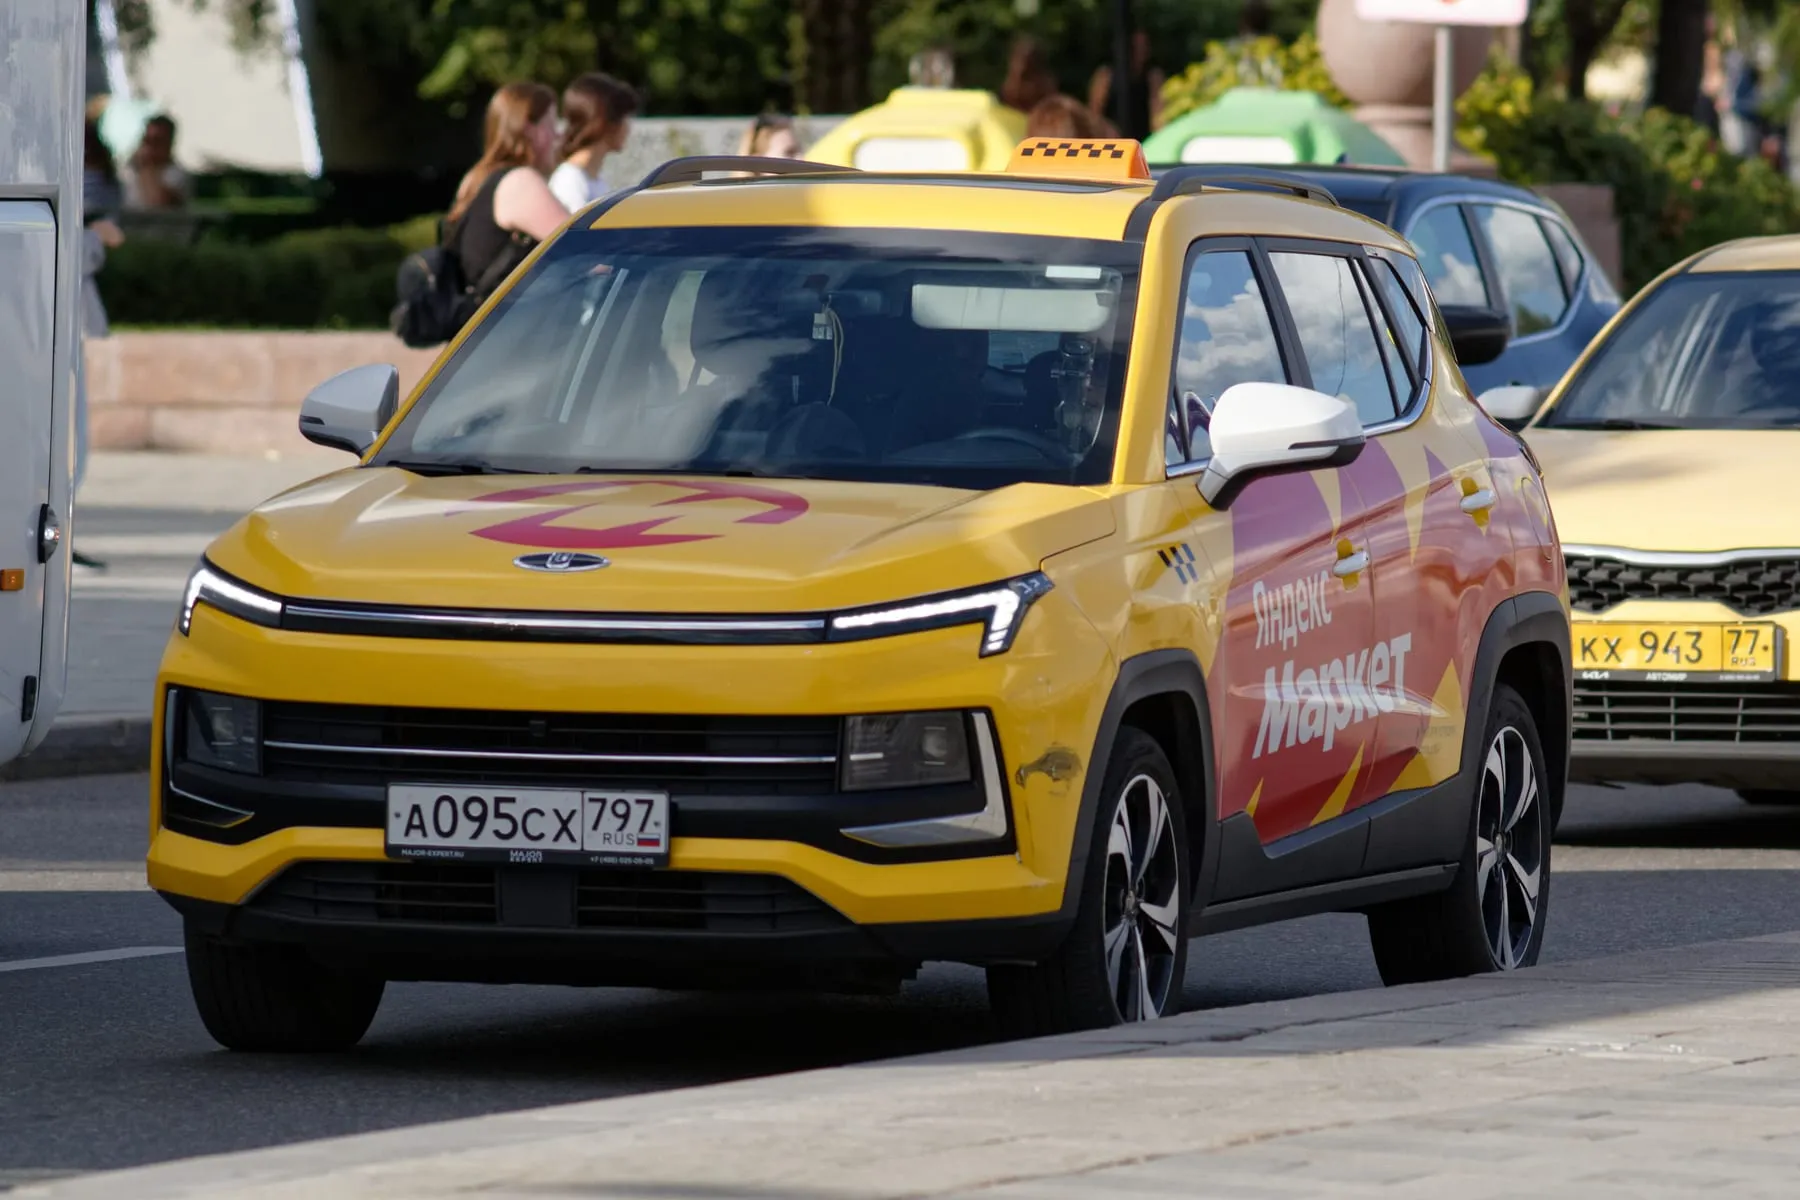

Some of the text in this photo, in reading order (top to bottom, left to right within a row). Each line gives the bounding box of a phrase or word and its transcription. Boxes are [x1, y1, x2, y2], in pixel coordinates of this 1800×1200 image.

[1253, 569, 1332, 651] Яндекс
[1639, 631, 1703, 664] 943
[1726, 629, 1760, 655] 77
[1730, 656, 1757, 666] RUS
[1252, 632, 1411, 759] Маркет
[587, 798, 655, 833] 797
[509, 850, 543, 858] MAJOR
[602, 832, 635, 846] RUS
